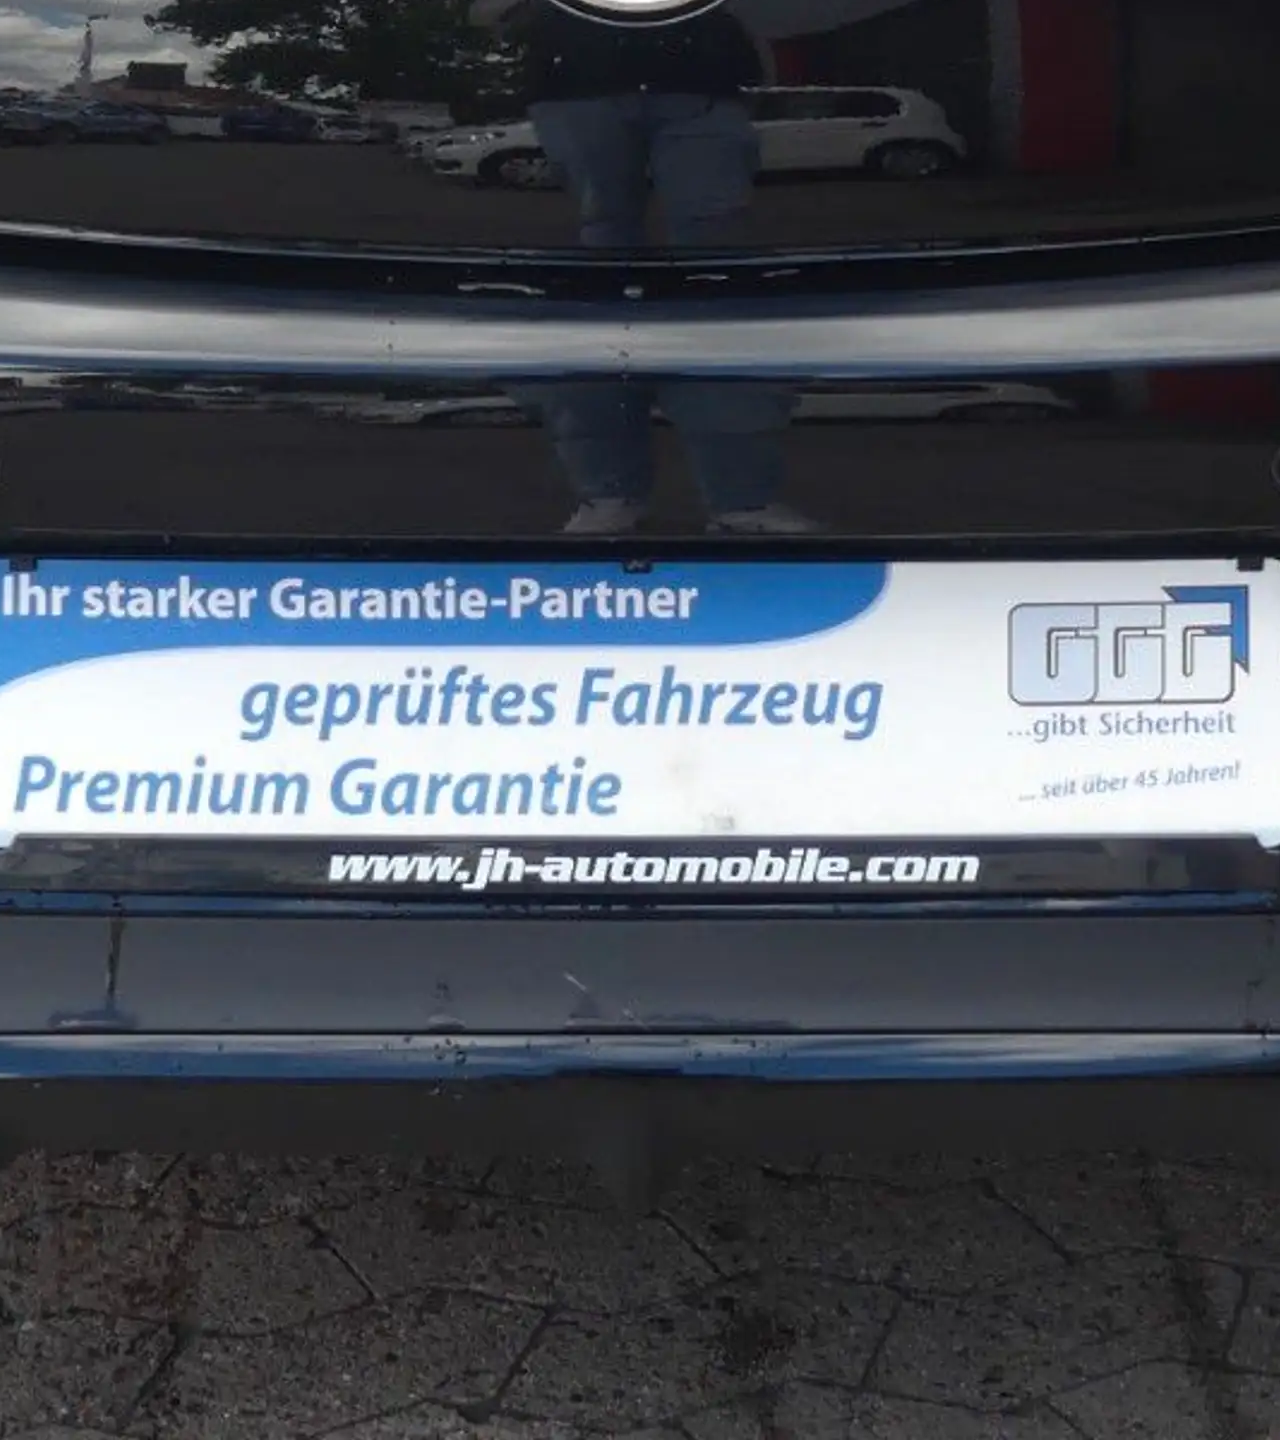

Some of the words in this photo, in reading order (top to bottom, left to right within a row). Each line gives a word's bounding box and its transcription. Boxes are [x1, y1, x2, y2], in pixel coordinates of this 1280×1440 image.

[2, 573, 70, 617] Ihr
[81, 575, 258, 620] starker
[269, 577, 699, 621] Garantie-Partner
[240, 664, 559, 742] geprüftes
[575, 664, 885, 742] Fahrzeug
[1098, 710, 1237, 737] Sicherheit
[13, 755, 310, 815] Premium
[329, 755, 623, 817] Garantie
[1082, 769, 1129, 796] über
[1134, 769, 1159, 788] 45
[1165, 759, 1242, 787] Jahren!
[327, 847, 981, 891] www.jh-automobile.com
